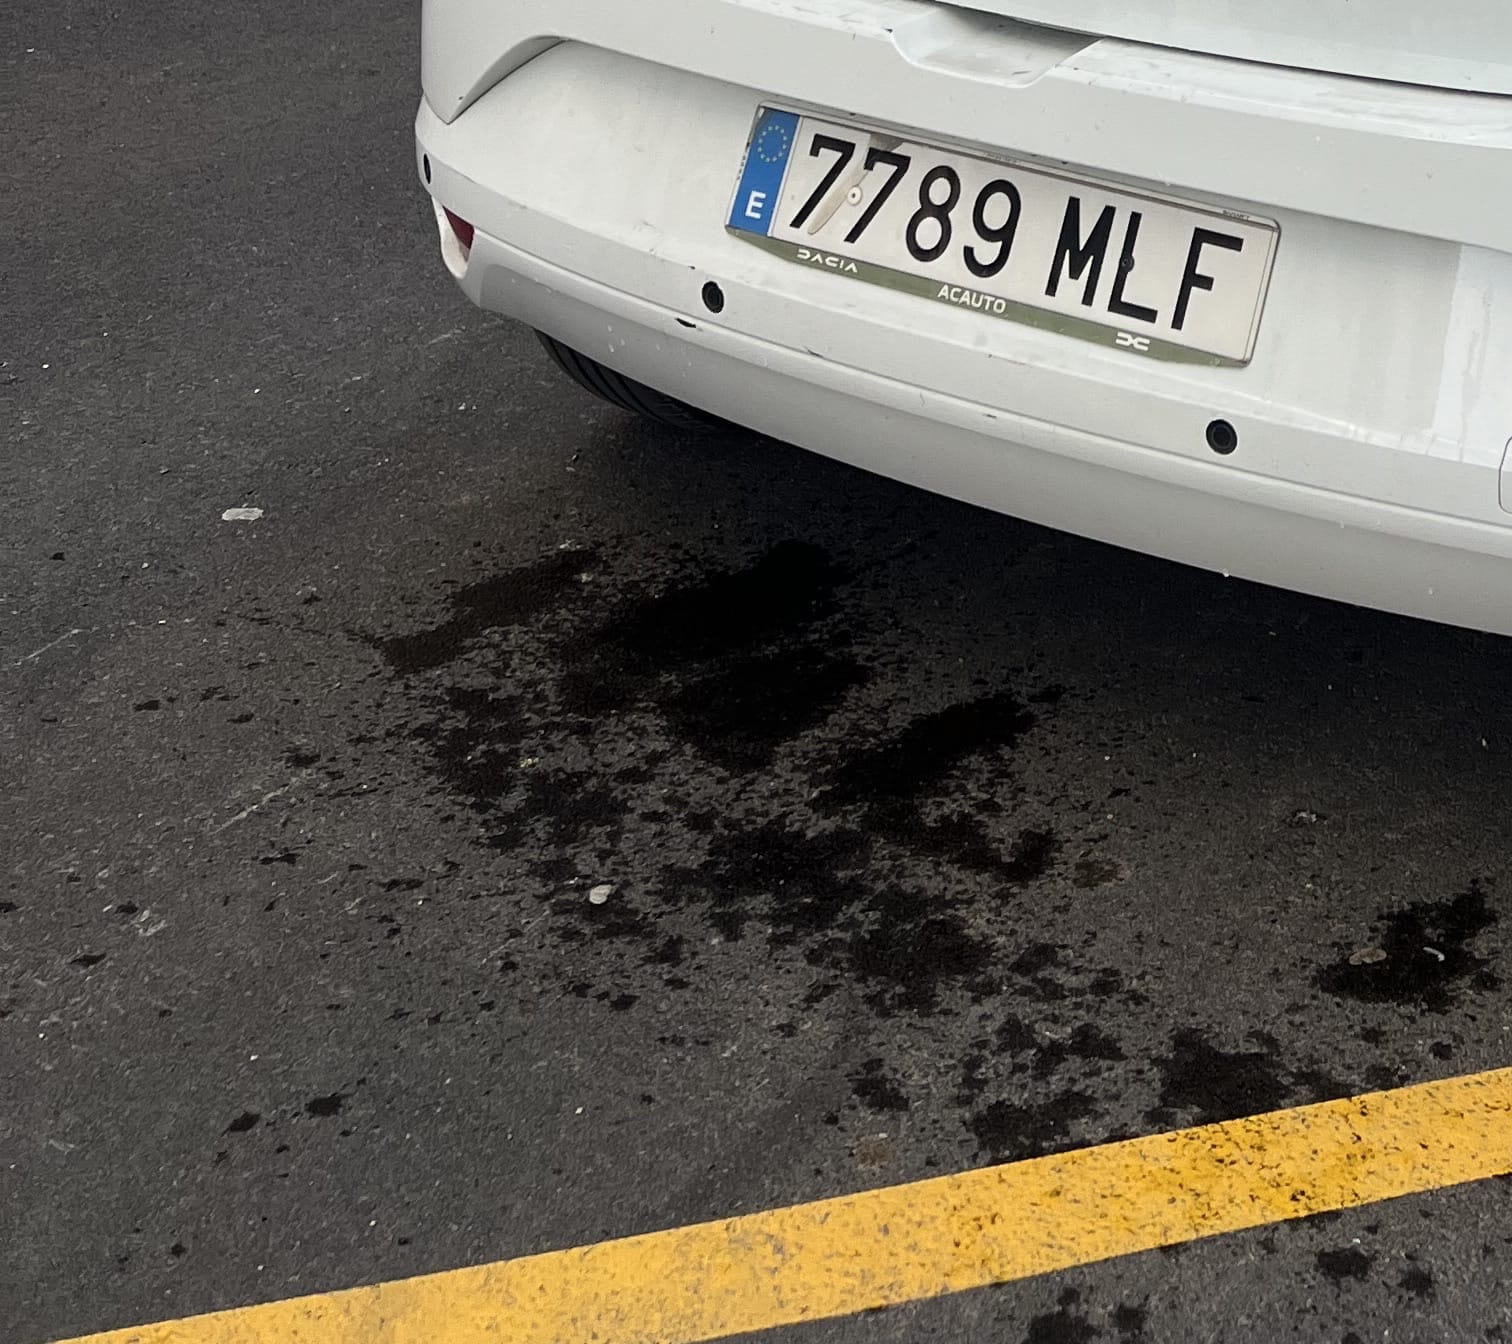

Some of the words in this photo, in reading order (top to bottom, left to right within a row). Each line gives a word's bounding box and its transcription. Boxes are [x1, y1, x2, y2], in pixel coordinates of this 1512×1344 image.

[744, 190, 765, 220] E
[790, 133, 1021, 278] 7789
[1045, 196, 1244, 330] MLF
[797, 248, 858, 273] DACIA
[937, 284, 1007, 314] ACAUTO
